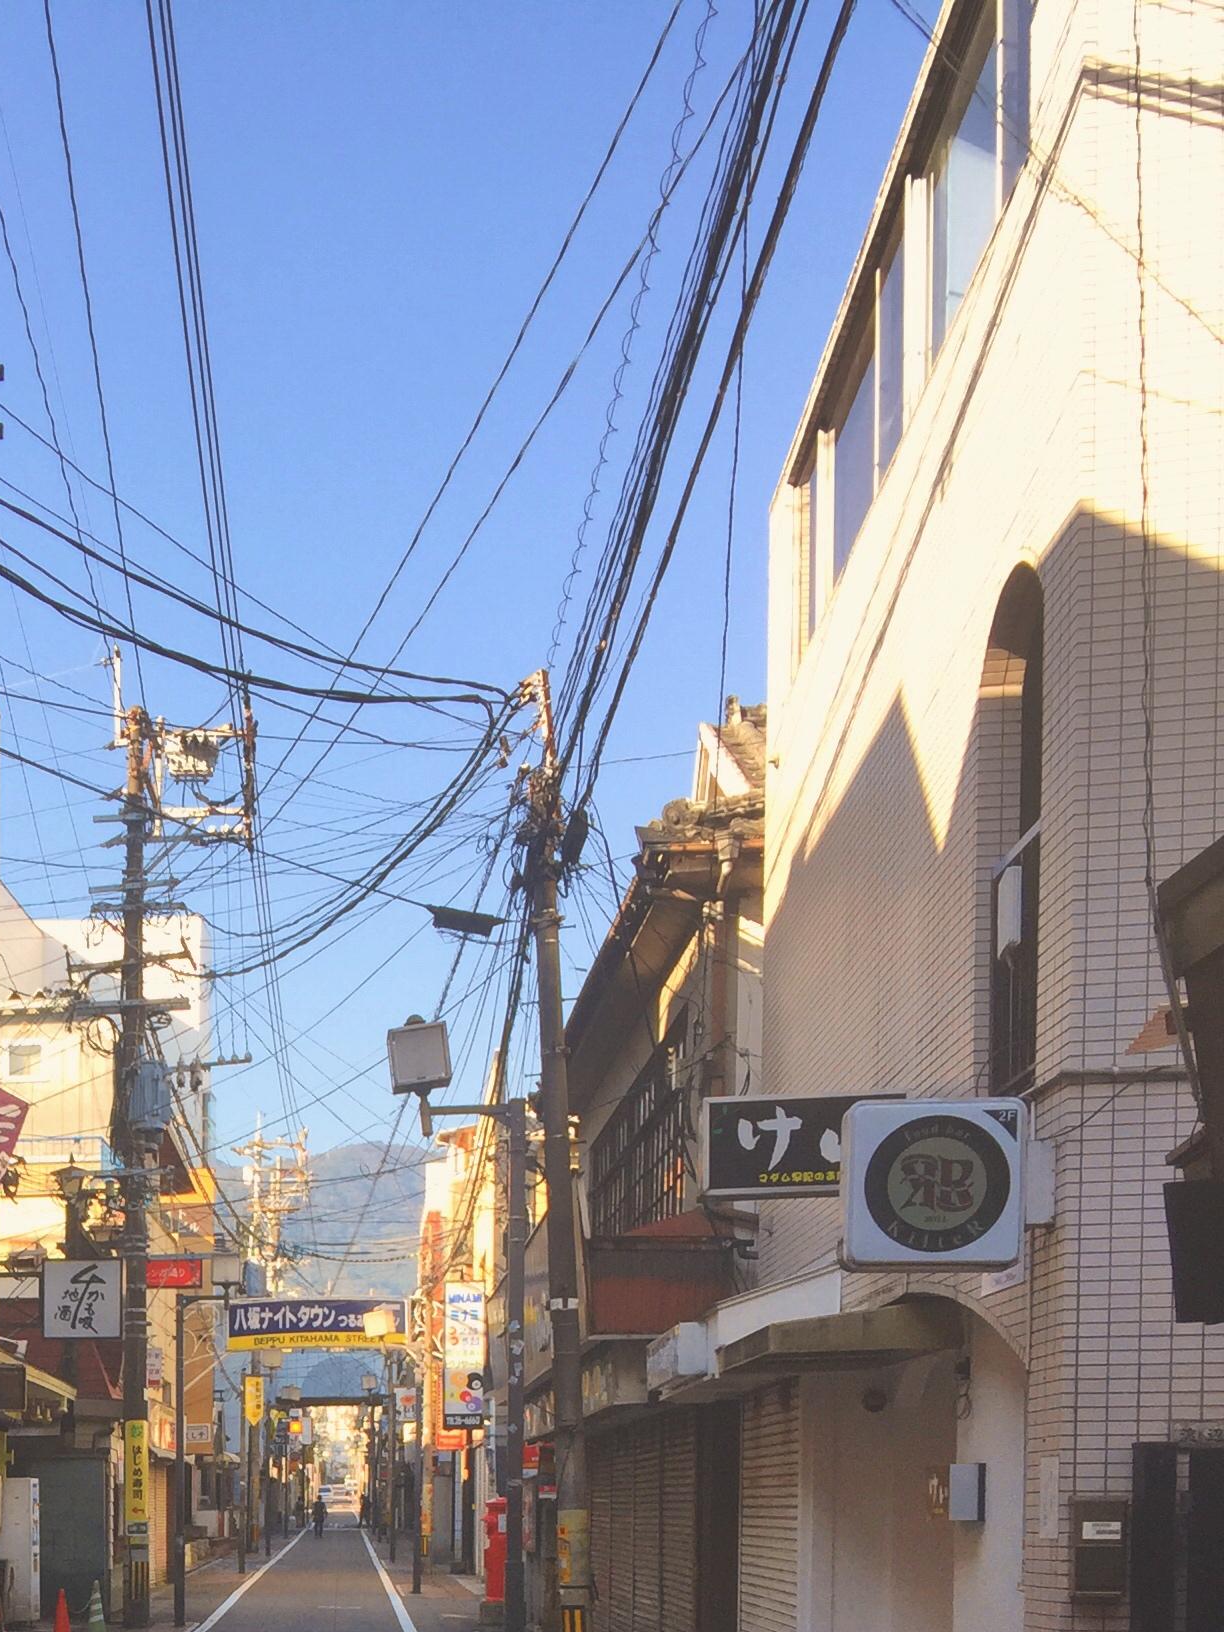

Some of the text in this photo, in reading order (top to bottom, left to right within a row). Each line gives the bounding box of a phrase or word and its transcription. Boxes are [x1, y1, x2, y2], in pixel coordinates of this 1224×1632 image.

[998, 1110, 1018, 1123] 2F
[54, 1288, 80, 1322] 地酒
[450, 1309, 479, 1322] ミナミ
[253, 1335, 286, 1346] BEPPU
[289, 1334, 341, 1344] KITAHAMA
[131, 1445, 144, 1501] はじめ寿司
